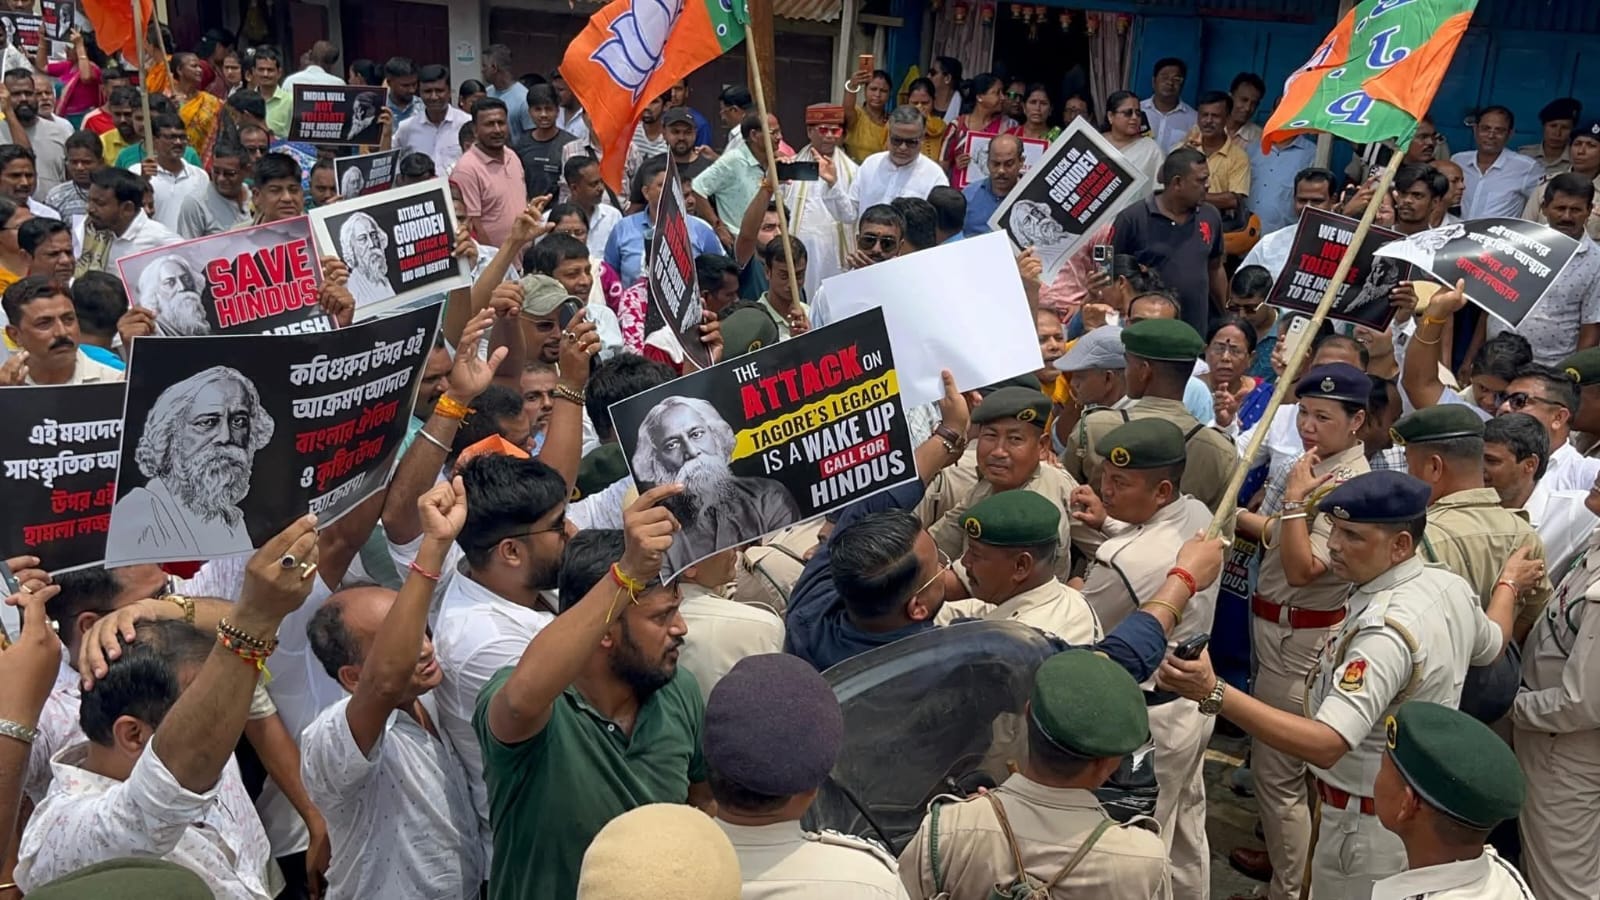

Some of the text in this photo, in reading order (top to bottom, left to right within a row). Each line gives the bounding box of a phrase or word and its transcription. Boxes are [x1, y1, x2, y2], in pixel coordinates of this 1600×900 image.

[303, 91, 345, 102] INDIA WILL
[301, 122, 315, 131] THE
[1044, 147, 1081, 186] ATTACK ON
[1048, 149, 1099, 204] GURUDEV
[397, 200, 436, 222] ATTACK ON
[1061, 201, 1073, 212] IS
[393, 213, 446, 245] GURUDEV
[1318, 223, 1353, 245] WE WI
[397, 247, 405, 258] IS
[405, 243, 415, 257] AN
[206, 238, 314, 299] SAVE
[402, 270, 414, 283] AND
[1292, 271, 1315, 288] THE
[214, 278, 319, 328] HINDUS
[1287, 285, 1302, 299] TO
[371, 341, 405, 369] উপর
[403, 328, 426, 356] এই
[732, 361, 761, 384] THE
[740, 342, 883, 420] ATTACK ON
[292, 385, 367, 419] আক্রমণ
[750, 379, 890, 450] TAGORE'S LEGACY
[28, 418, 58, 446] এই
[295, 419, 357, 453] বাংলার
[763, 401, 896, 475] IS A WAKE UP
[300, 465, 314, 488] ও
[355, 435, 385, 464] উপর
[824, 438, 886, 474] CALL FOR
[810, 450, 906, 508] HINDUS
[51, 490, 92, 513] উপর
[23, 520, 76, 547] হামলা
